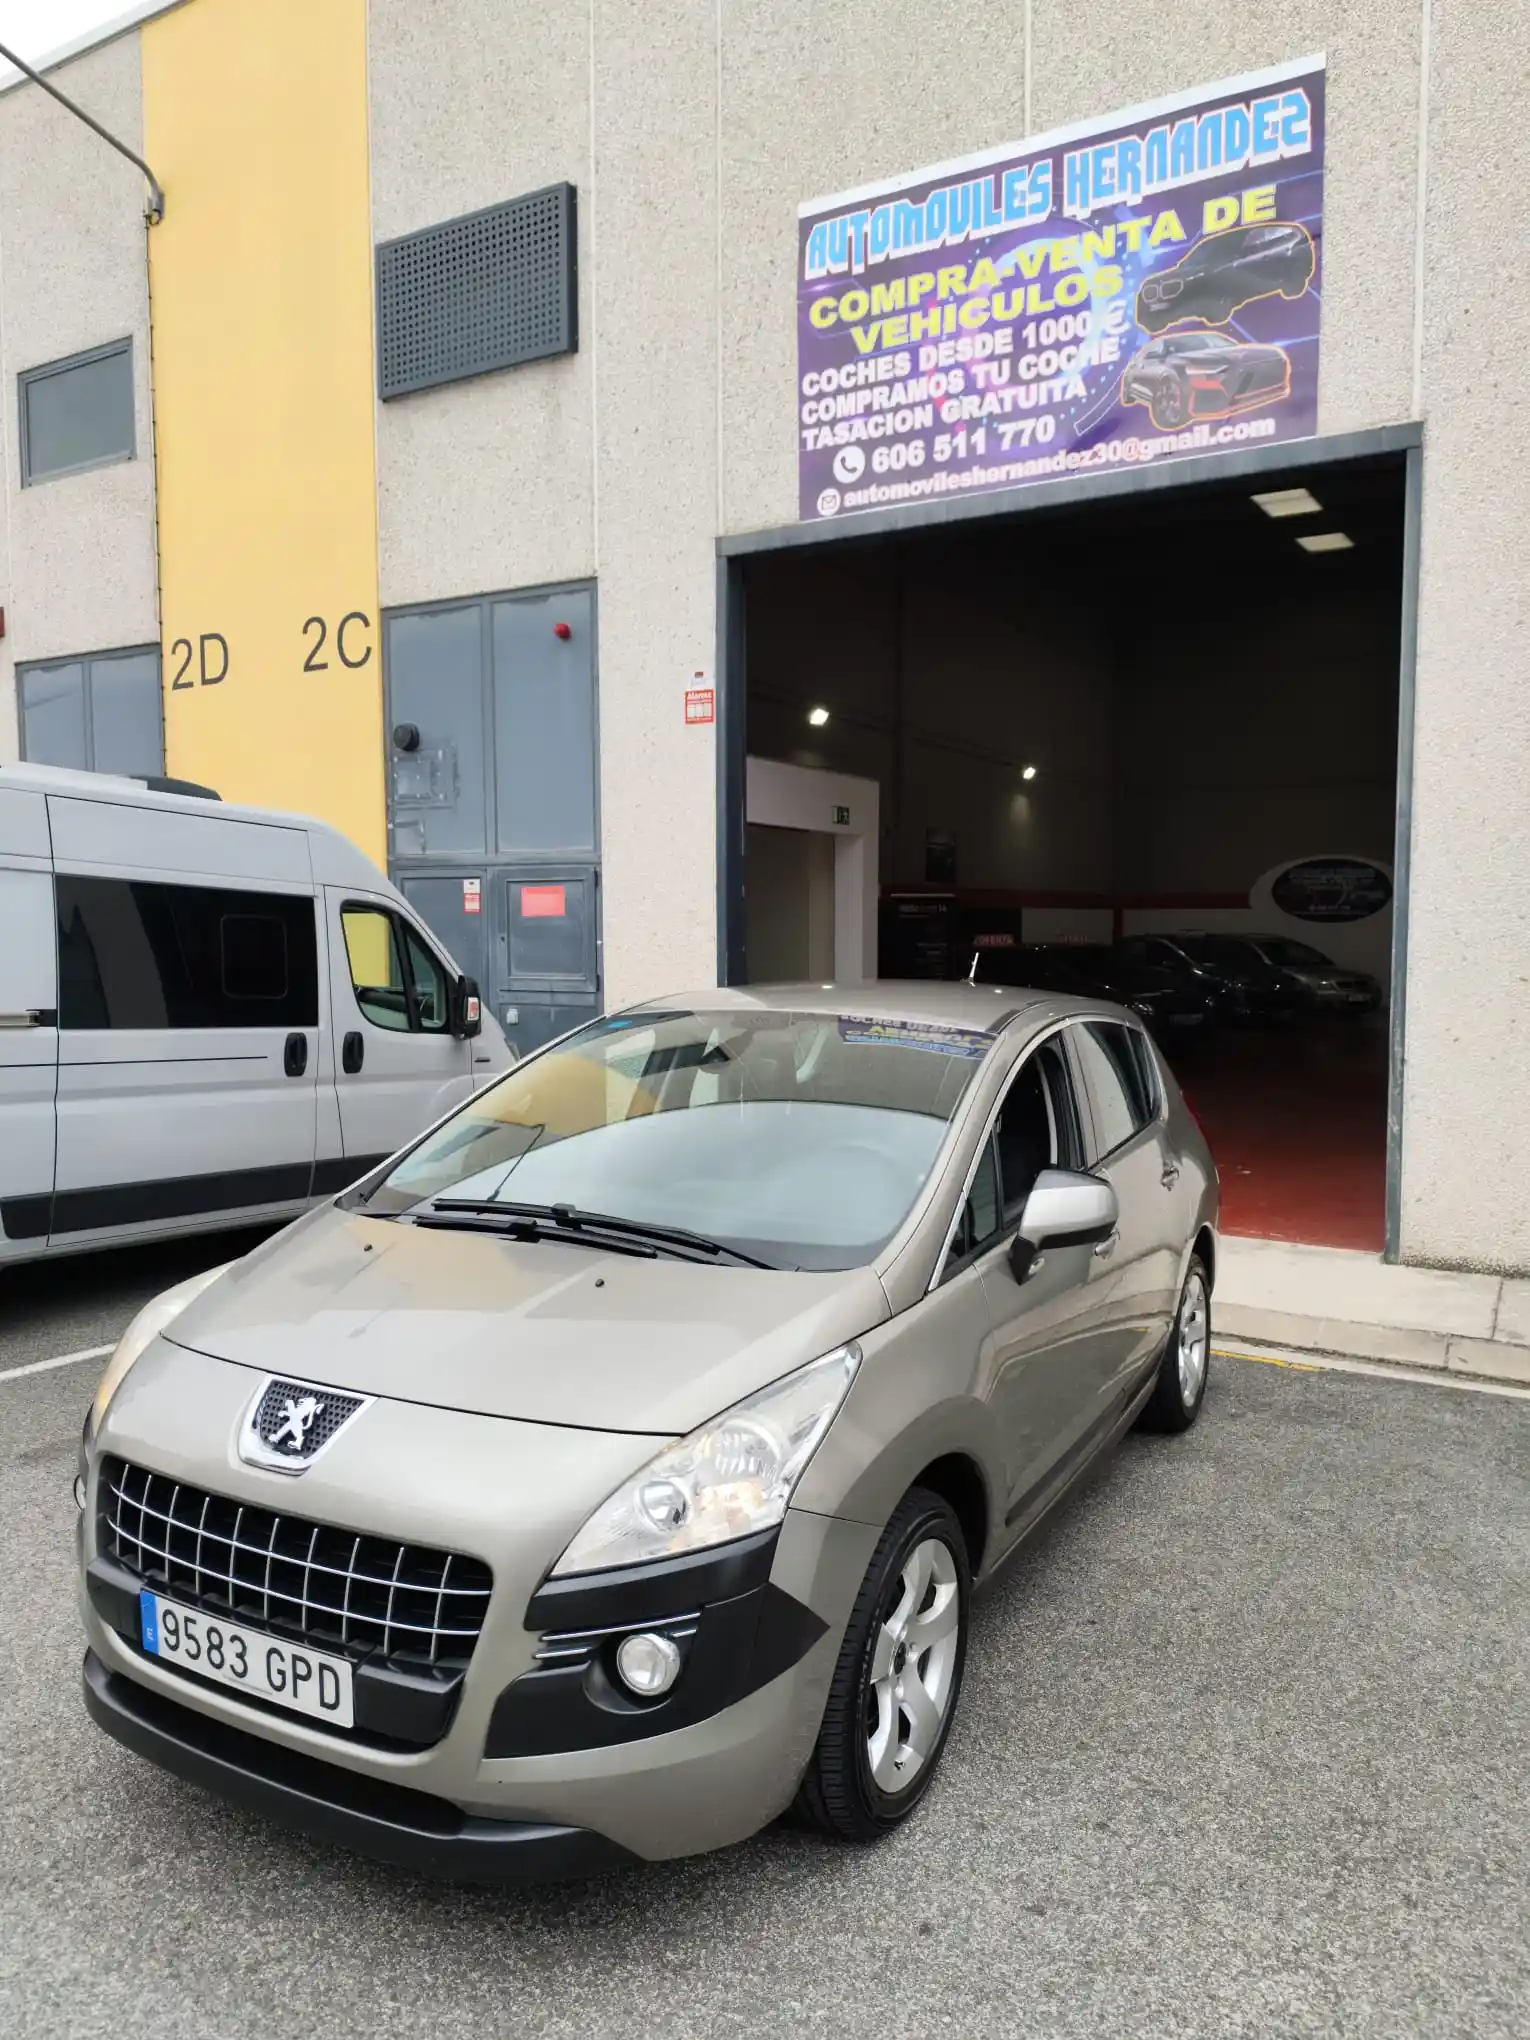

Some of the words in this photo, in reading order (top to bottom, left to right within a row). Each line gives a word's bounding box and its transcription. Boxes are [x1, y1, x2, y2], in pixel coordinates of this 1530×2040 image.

[805, 159, 1053, 279] AUTOMOVILES
[1063, 88, 1311, 219] HERNANDEZ
[809, 209, 1187, 328] COMPRA-VENTA
[1202, 184, 1277, 234] DE
[802, 351, 911, 396] COCHES
[918, 326, 1013, 371] DESDE
[1022, 310, 1092, 348] 1000
[1102, 299, 1131, 335] €
[850, 265, 1123, 354] VEHICULOS
[801, 368, 965, 425] COMPRAMOS
[971, 358, 1011, 389] TU
[1018, 336, 1120, 380] COCHE
[801, 404, 933, 451] TASACION
[940, 373, 1087, 423] GRATUITA
[843, 416, 1276, 508] automovileshernandez30@gmail.com
[872, 440, 925, 473] 606
[933, 428, 986, 463] 511
[998, 415, 1056, 451] 770
[171, 632, 229, 691] 2D
[302, 611, 372, 672] 2C
[162, 1609, 249, 1679] 9583
[266, 1647, 341, 1712] GPD
